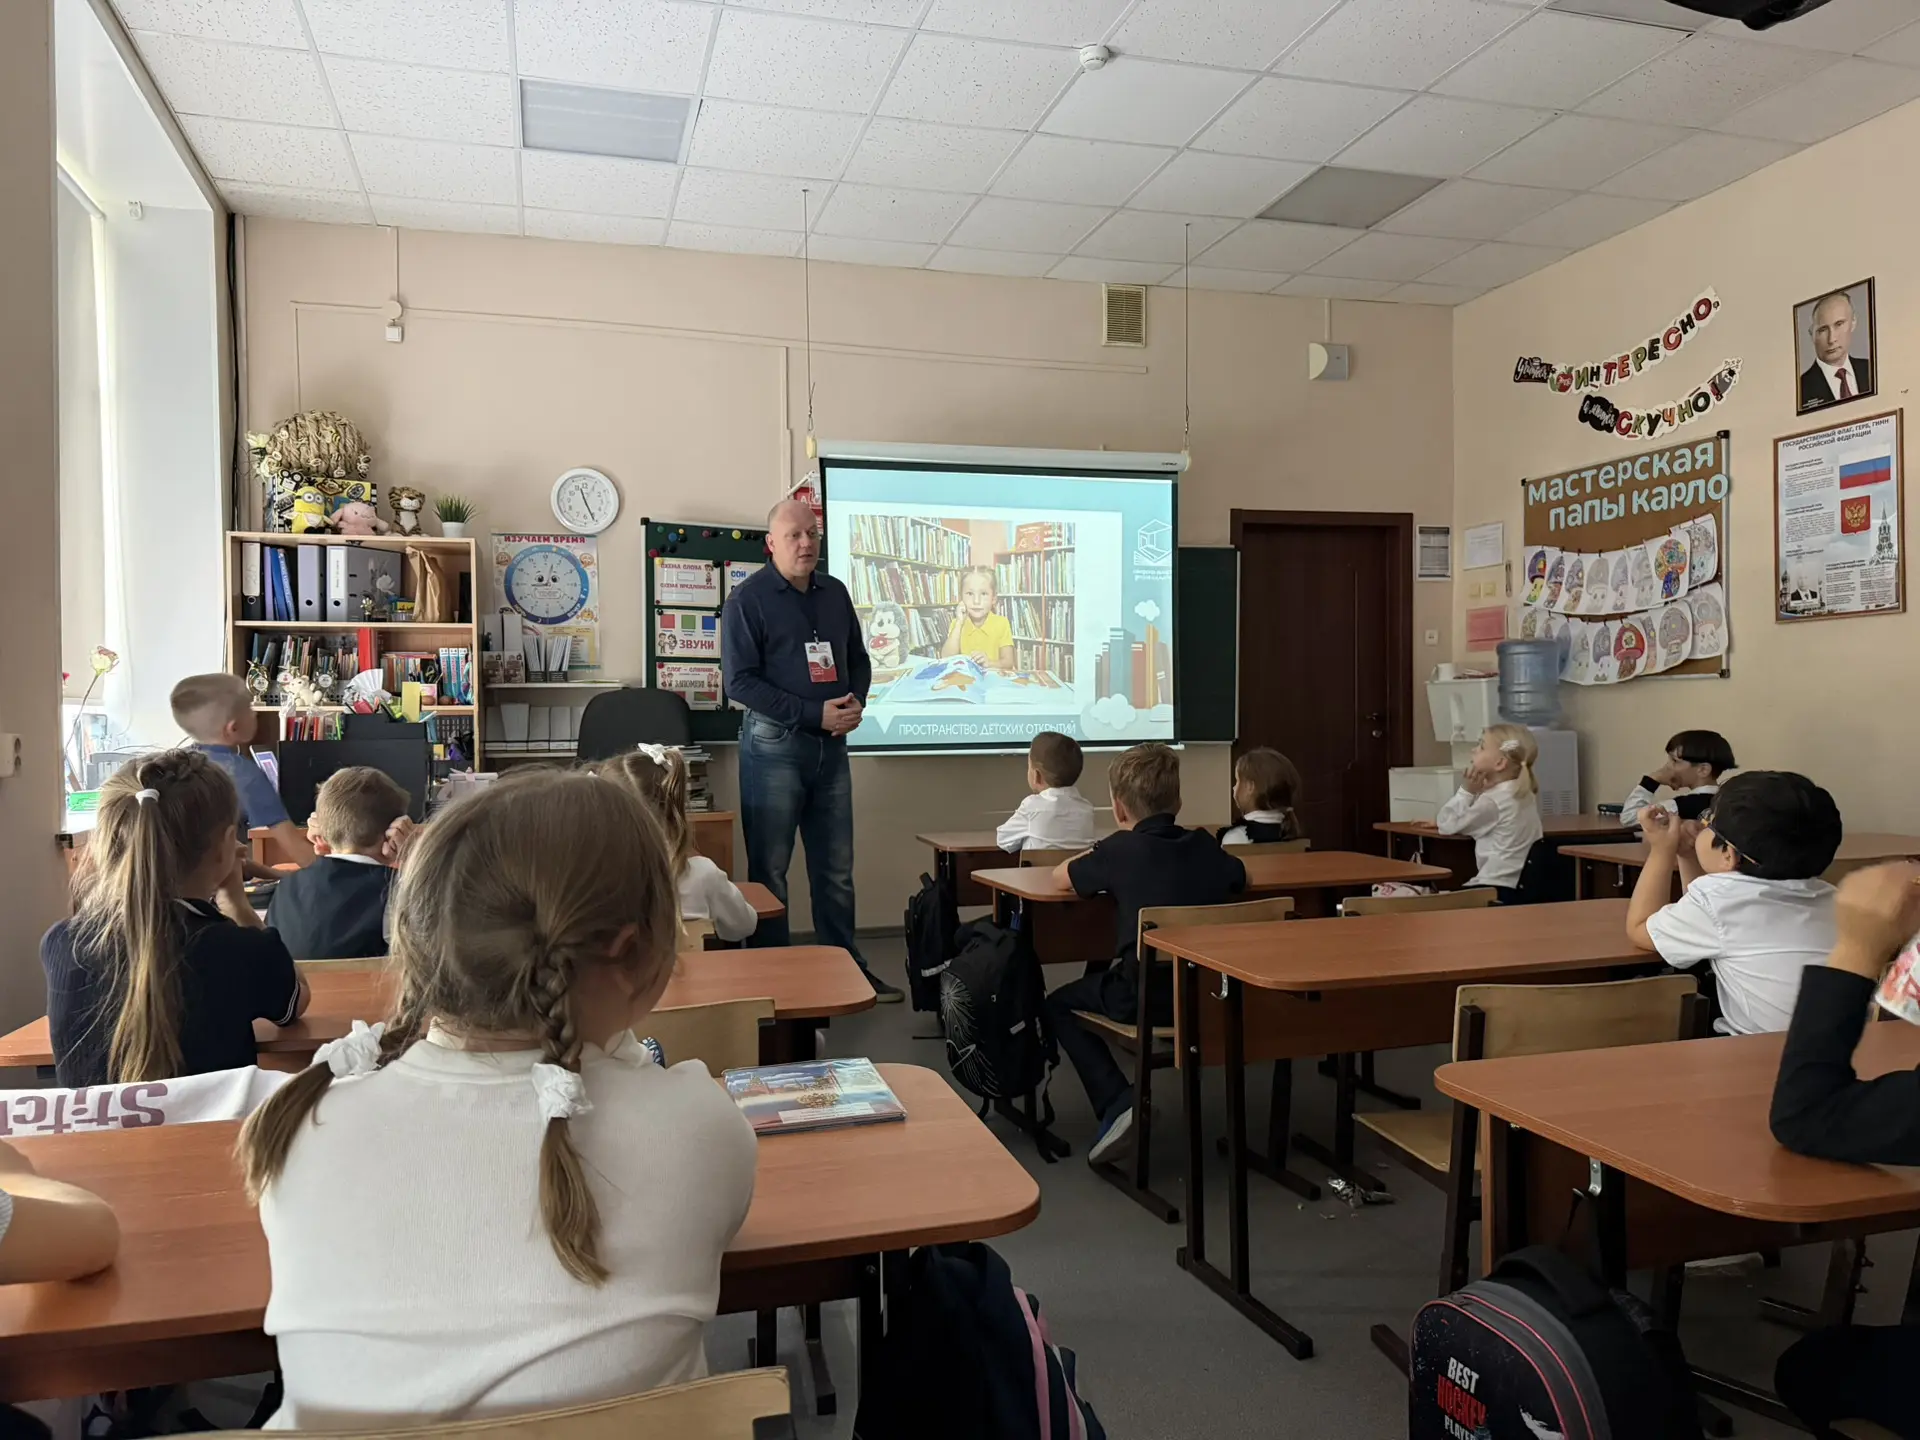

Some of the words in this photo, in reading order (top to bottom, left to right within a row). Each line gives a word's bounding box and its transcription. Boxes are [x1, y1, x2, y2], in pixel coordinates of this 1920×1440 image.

[1782, 431, 1837, 448] ГОСУДАРСТВЕННЫЙ
[1798, 437, 1836, 451] РОССИЙСКОЙ
[1837, 430, 1872, 442] ФЕДЕРАЦИИ
[504, 535, 550, 543] ИЗУЧАЕМ
[553, 536, 586, 544] ВРЕМЯ
[679, 639, 715, 650] ЗВУКИ
[899, 723, 977, 736] ПРОСТРАНСТВО
[979, 723, 1024, 736] ДЕТСКИХ
[1447, 1356, 1479, 1394] BEST
[1437, 1373, 1487, 1433] HOCKEY
